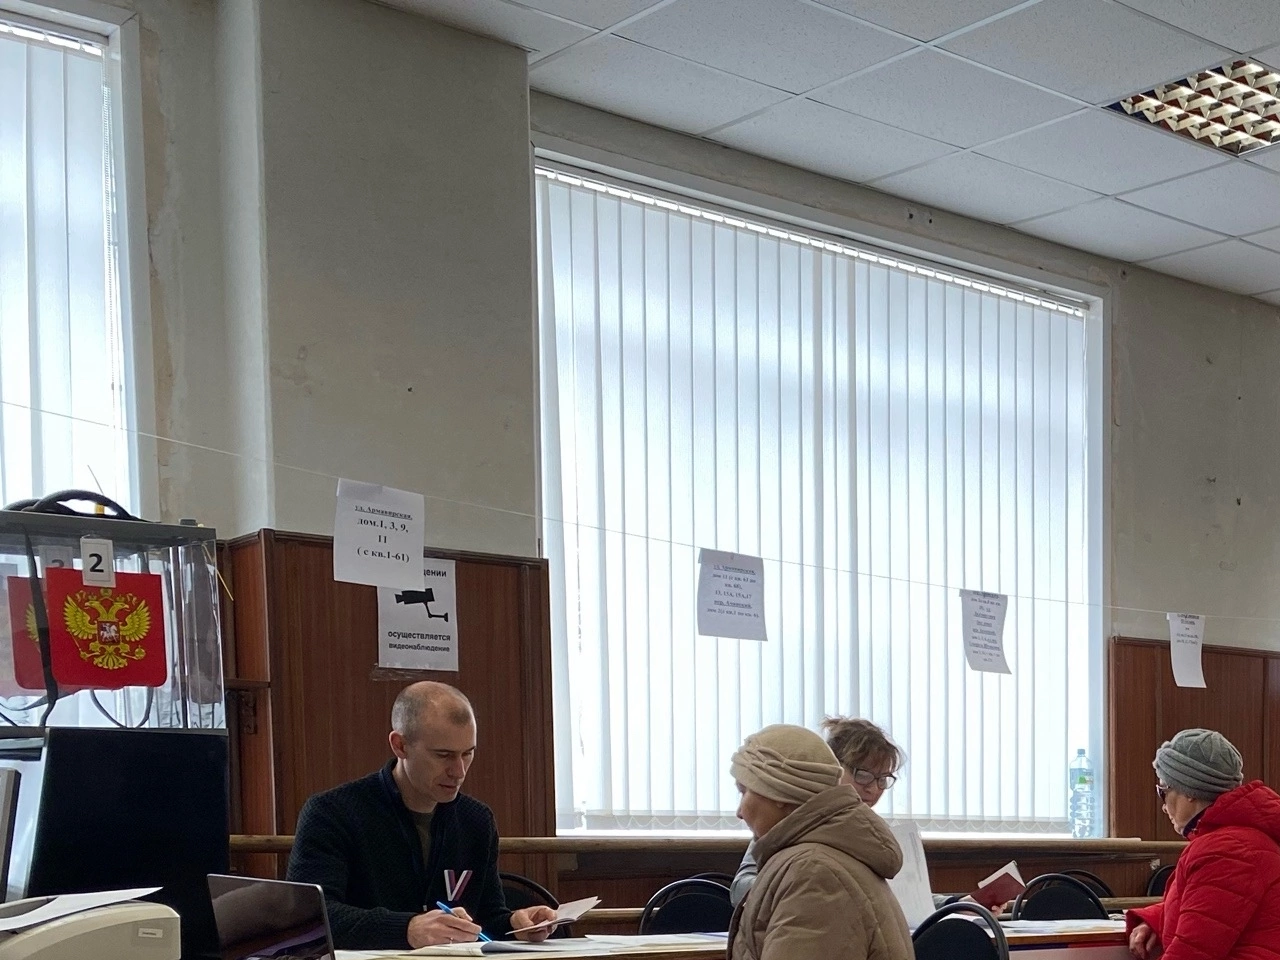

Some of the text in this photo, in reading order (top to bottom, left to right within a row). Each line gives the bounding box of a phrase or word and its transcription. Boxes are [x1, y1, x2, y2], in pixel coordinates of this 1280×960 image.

[378, 534, 387, 544] 11
[88, 553, 105, 573] 2
[388, 630, 451, 641] осуществляется
[388, 642, 450, 652] видеонаблюдение
